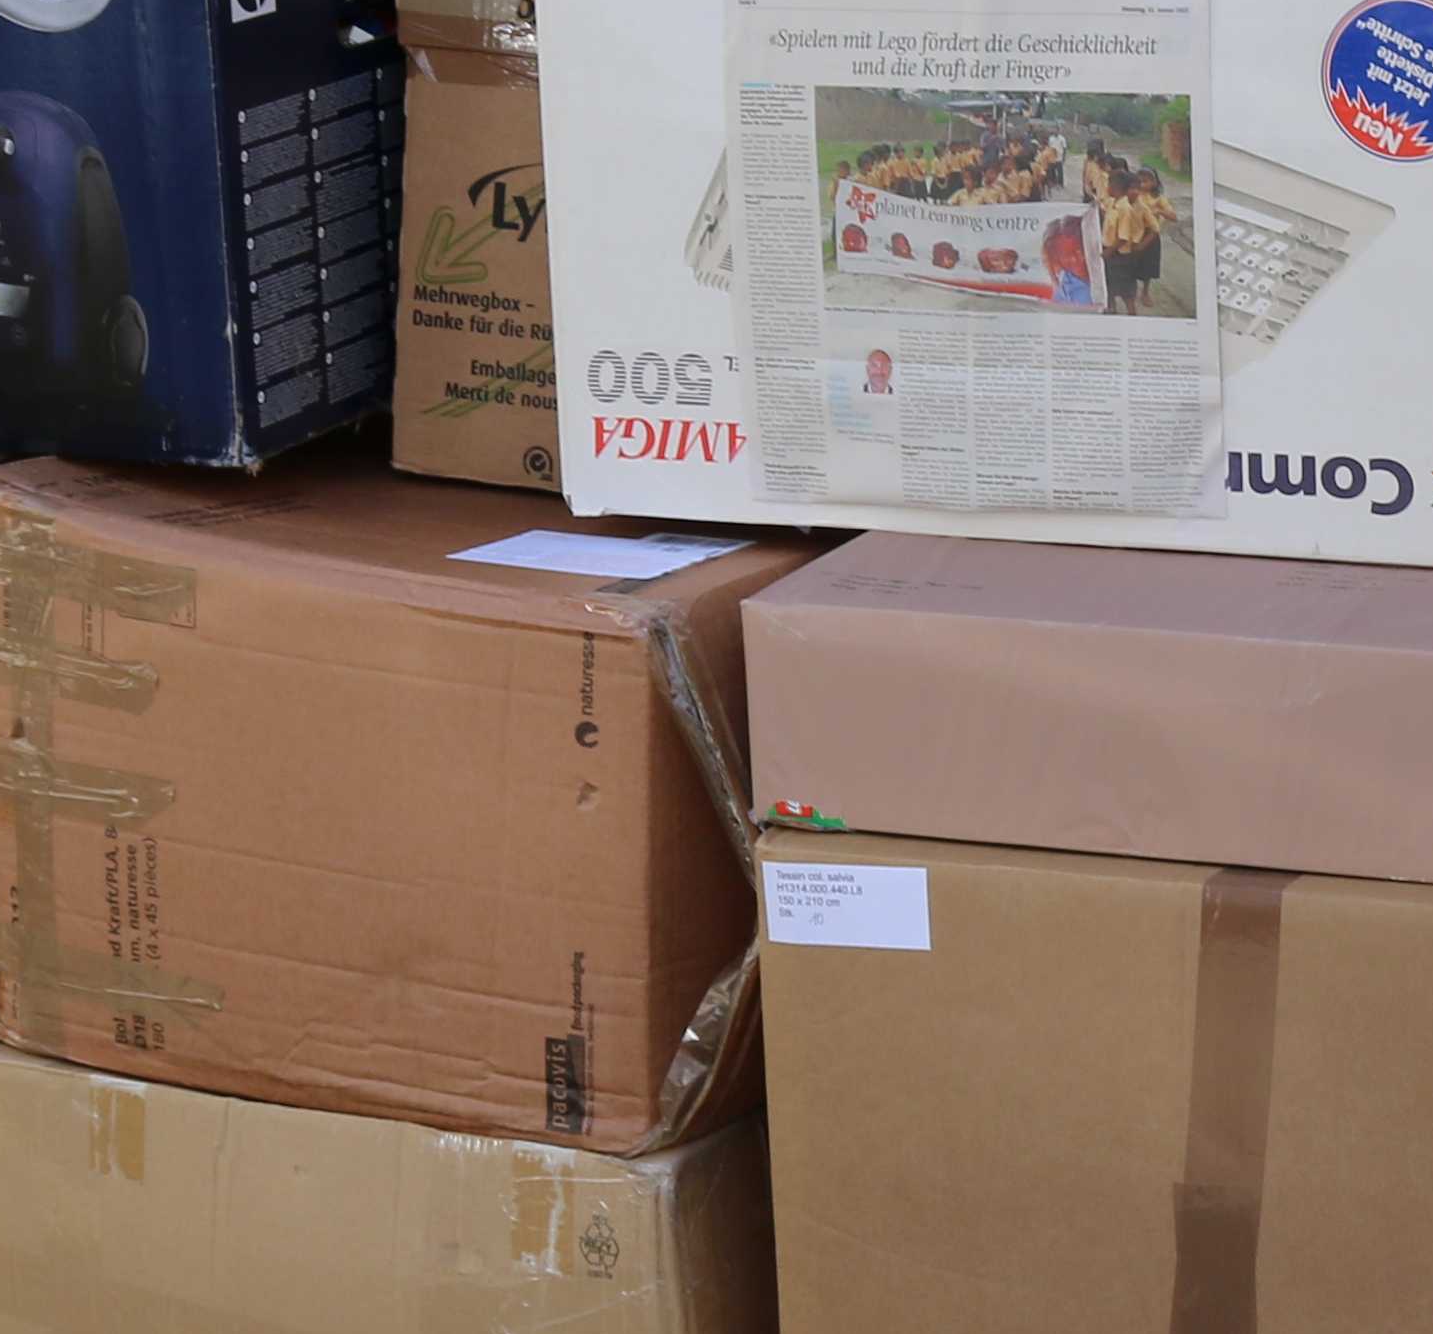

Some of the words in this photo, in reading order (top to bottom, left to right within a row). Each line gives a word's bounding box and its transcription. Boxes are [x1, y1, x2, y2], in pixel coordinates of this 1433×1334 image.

[843, 30, 872, 50] mit
[877, 32, 918, 55] Lego
[920, 30, 980, 57] fördert
[984, 33, 1013, 54] die
[1017, 34, 1158, 56] Geschicklichkeit
[851, 57, 886, 76] und
[890, 58, 918, 77] die
[922, 58, 968, 83] Kraft
[969, 59, 1001, 79] der
[1366, 62, 1394, 86] mit
[1393, 75, 1431, 108] Jetzt
[1352, 112, 1404, 156] Neu
[413, 284, 522, 313] Mehrwegbox
[412, 309, 465, 332] Danke
[470, 314, 493, 336] für
[498, 317, 525, 339] die
[470, 359, 557, 388] Emballage
[586, 349, 714, 407] 500
[444, 381, 490, 405] Merci
[494, 386, 516, 406] de
[591, 415, 748, 465] AMIGA
[579, 630, 596, 717] naturesse
[125, 843, 141, 931] naturesse
[827, 872, 856, 884] salvia
[143, 901, 159, 927] 45
[778, 895, 796, 906] 150
[804, 896, 824, 908] 210
[825, 898, 841, 908] cm
[113, 1016, 129, 1045] Bol
[546, 1043, 571, 1130] pacovis
